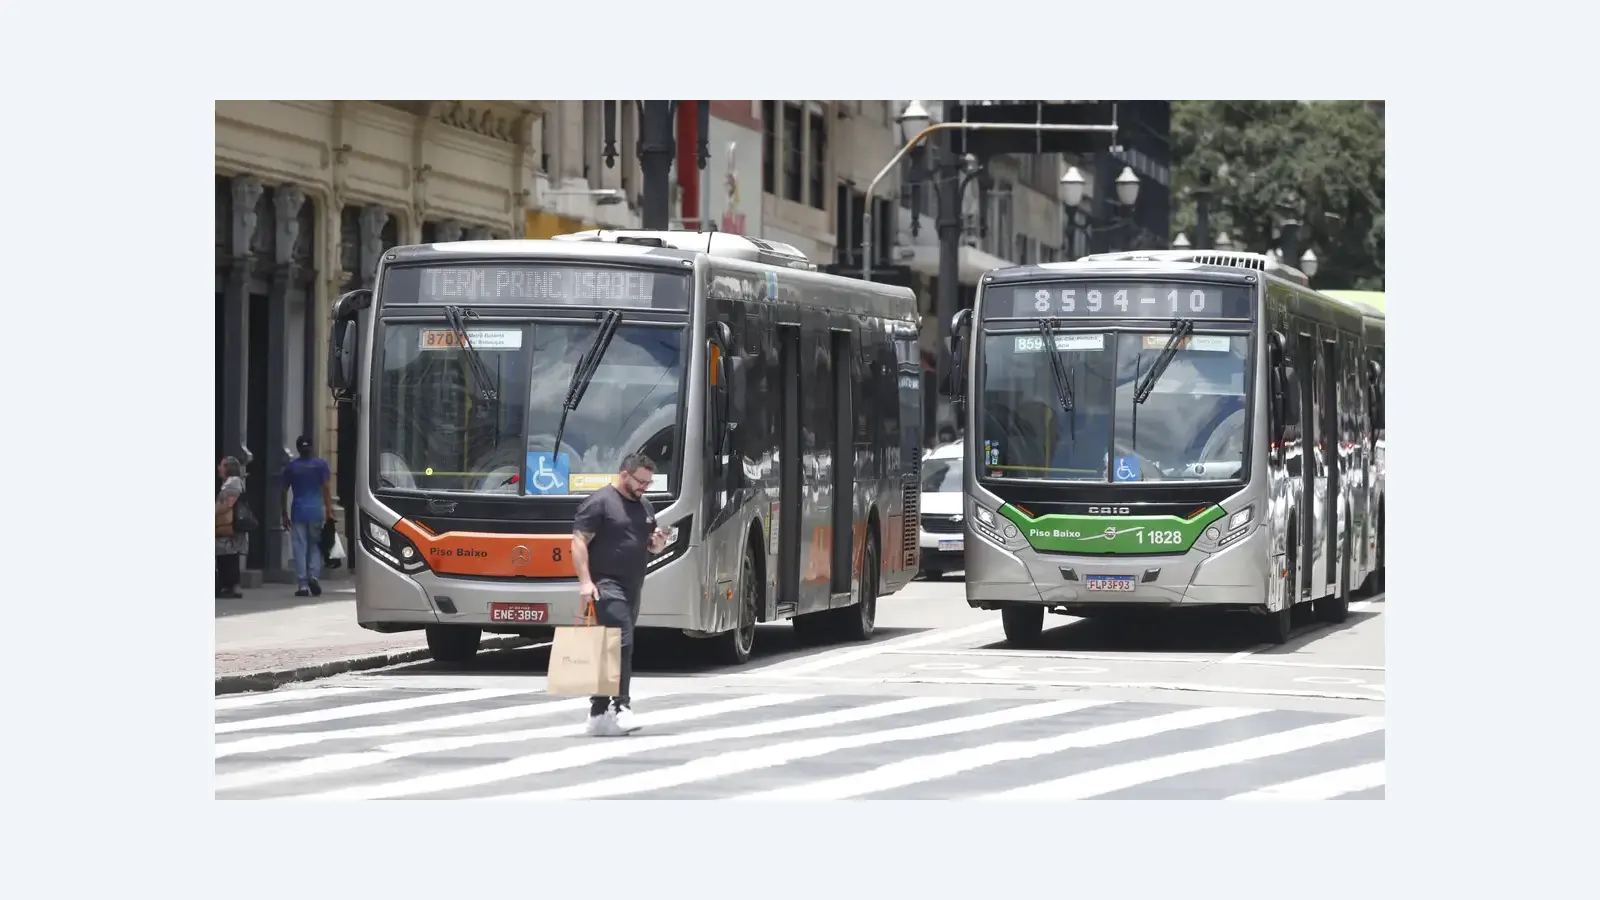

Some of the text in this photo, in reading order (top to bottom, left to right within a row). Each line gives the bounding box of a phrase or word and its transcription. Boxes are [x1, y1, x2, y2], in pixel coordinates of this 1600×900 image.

[426, 268, 653, 300] TERM. PRINC. ISABEL
[1034, 289, 1206, 312] 8594-10
[1018, 338, 1048, 350] 859
[1088, 506, 1131, 514] CAIO
[1029, 529, 1081, 538] Piso Baixo
[429, 547, 488, 558] Piso Baixo
[552, 547, 562, 562] 8
